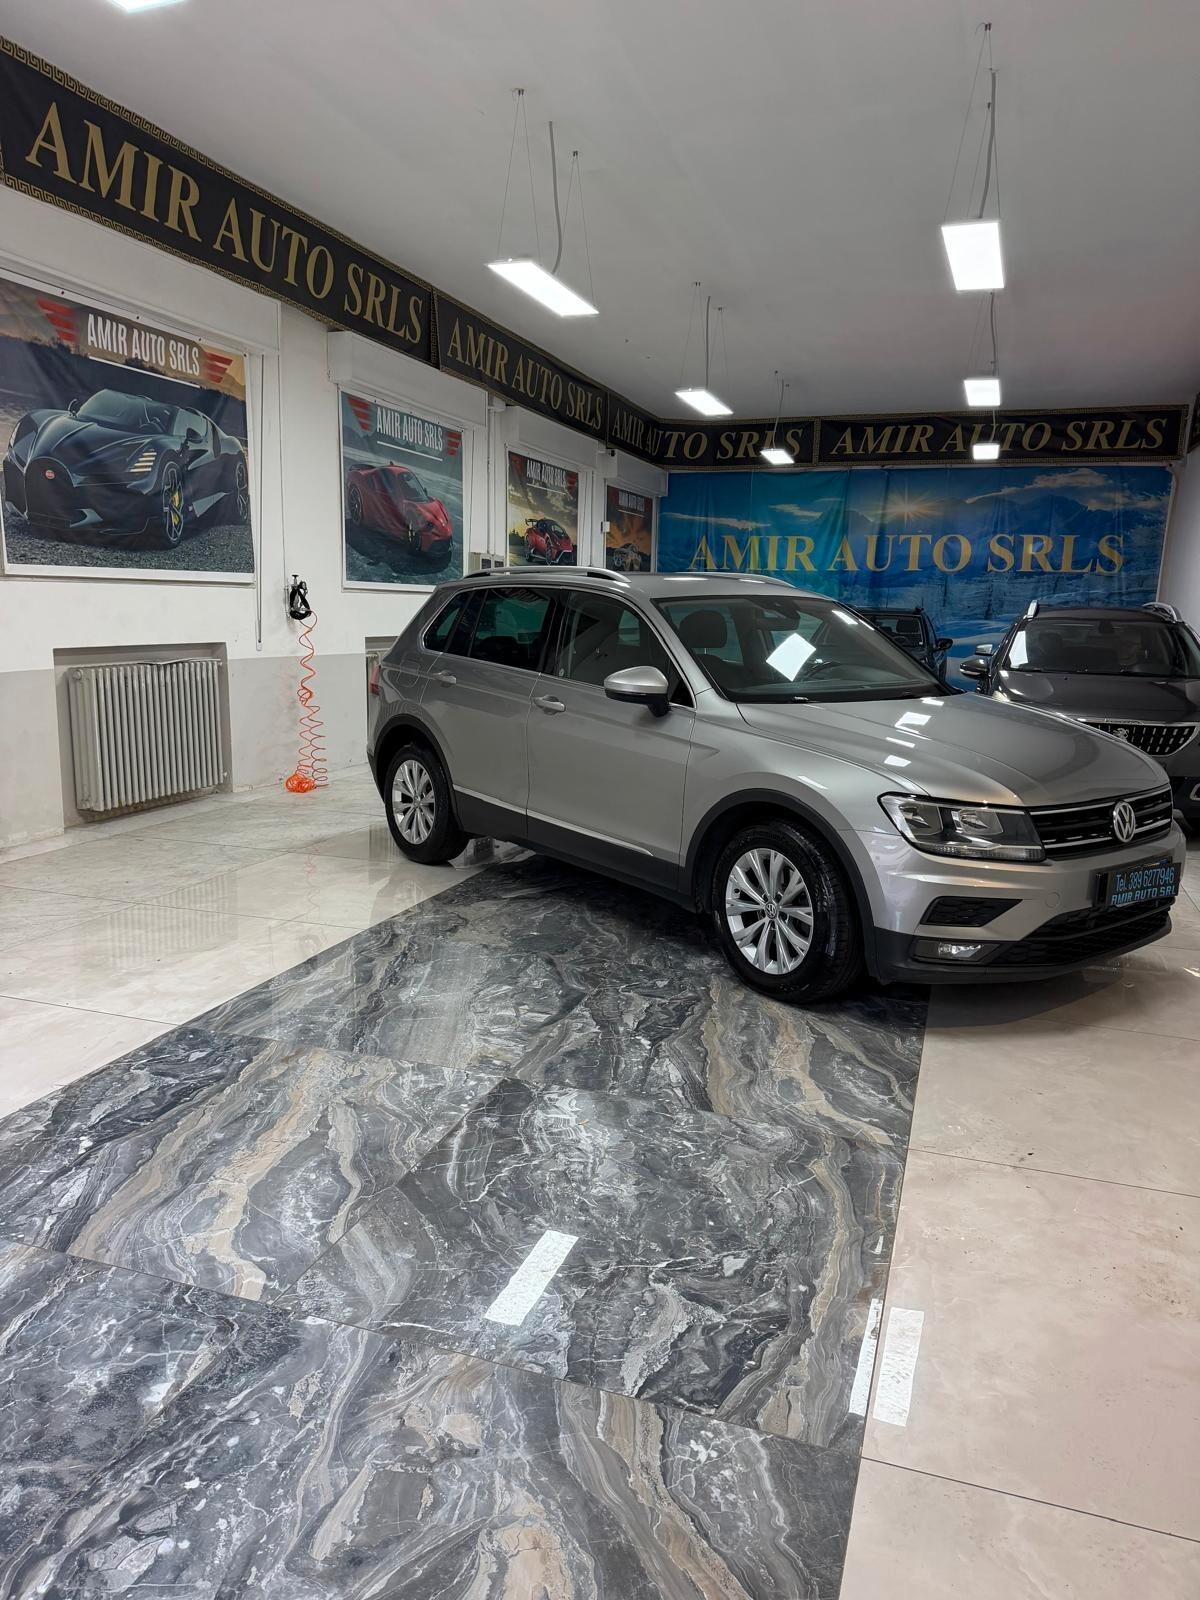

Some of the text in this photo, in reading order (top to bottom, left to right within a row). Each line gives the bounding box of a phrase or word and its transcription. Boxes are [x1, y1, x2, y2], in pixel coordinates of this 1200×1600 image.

[25, 101, 423, 344] AMIR AUTO SRLS
[87, 313, 200, 377] AMIR AUTO SRLS
[447, 317, 602, 430] AMIR AUTO SRLS
[377, 406, 443, 451] AMIR AUTO SRLS
[612, 407, 644, 450] AMIR
[645, 425, 707, 460] AUTO
[830, 424, 939, 454] AMIR
[1061, 418, 1168, 450] SRLS
[686, 533, 1125, 575] AMIR AUTO SRLS
[1111, 884, 1176, 905] AMIR AUTO SRL
